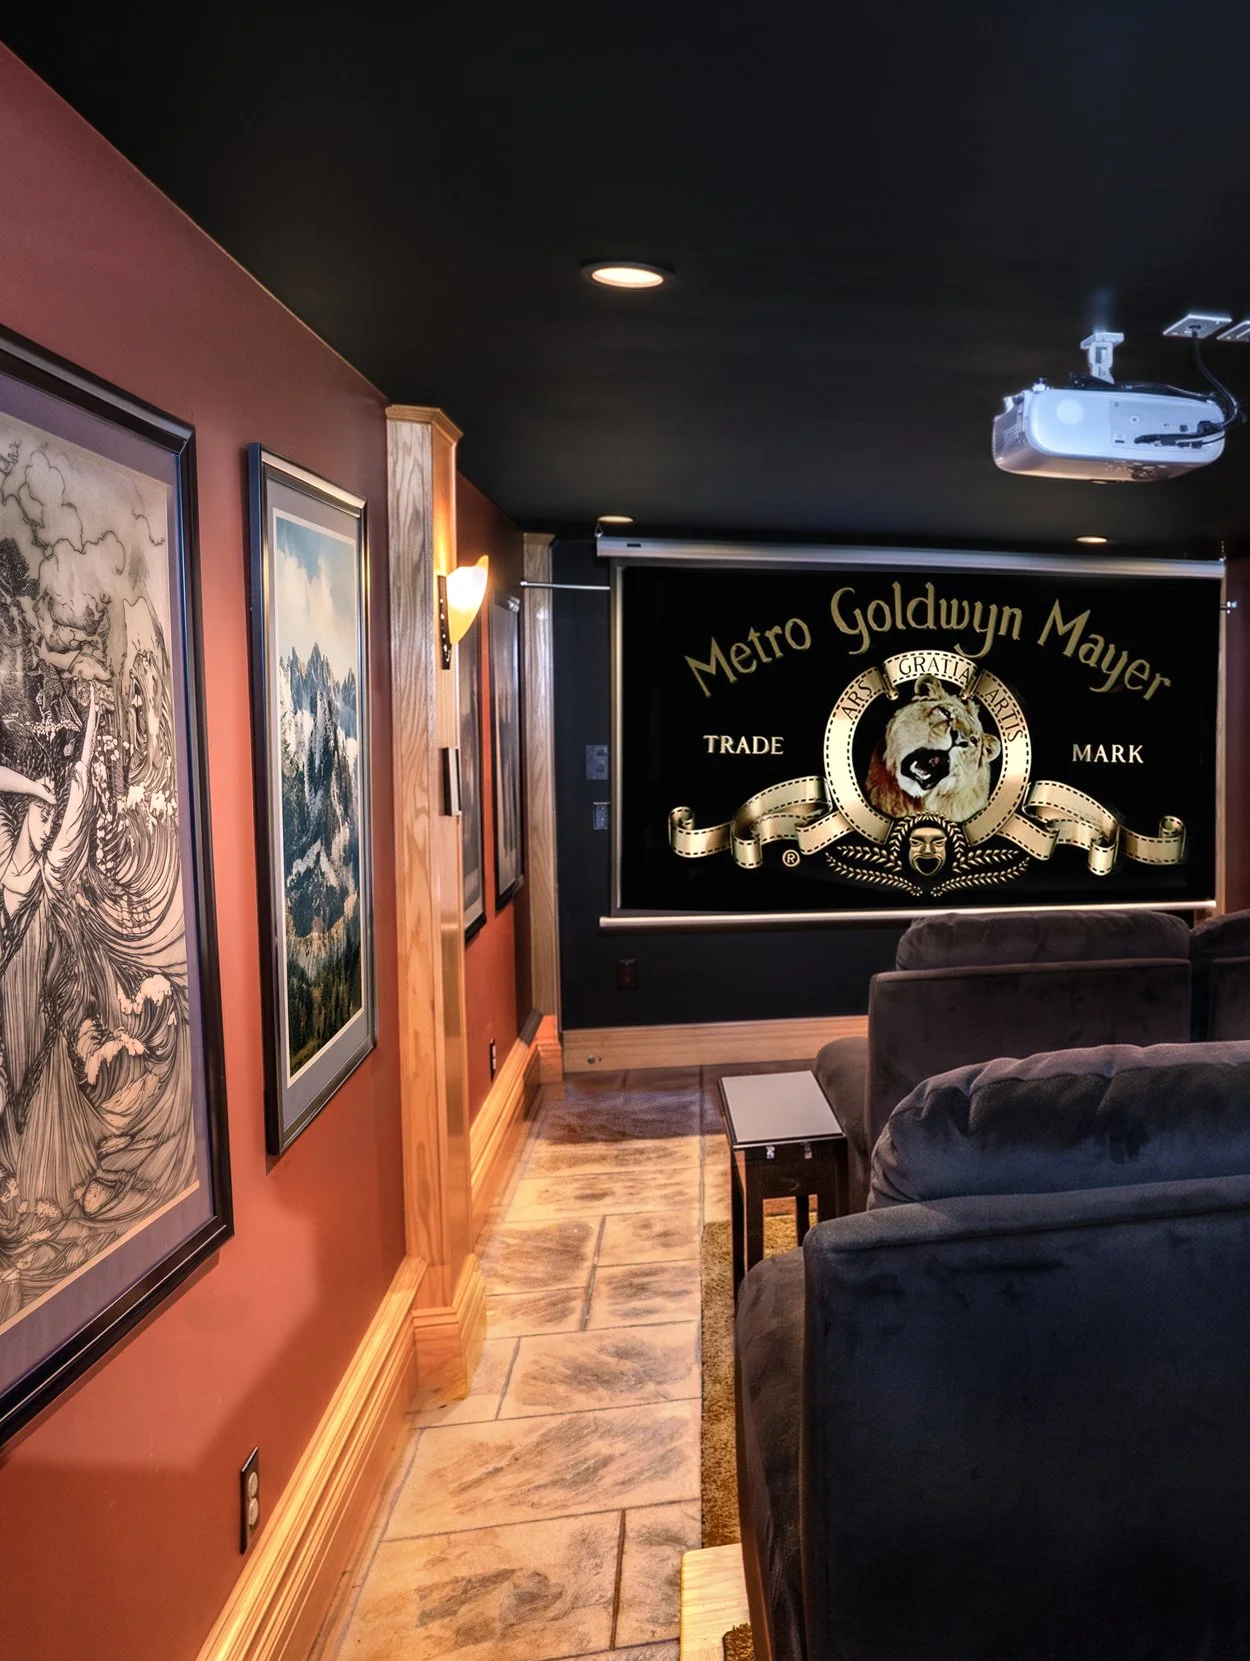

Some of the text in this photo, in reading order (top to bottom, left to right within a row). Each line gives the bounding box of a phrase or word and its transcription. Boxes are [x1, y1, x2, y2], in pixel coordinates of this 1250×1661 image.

[684, 580, 1172, 701] Metro Goldwyn Mayer
[839, 655, 1024, 743] ARS GRATIA ARTIS
[703, 735, 1144, 764] TRADE MARK
